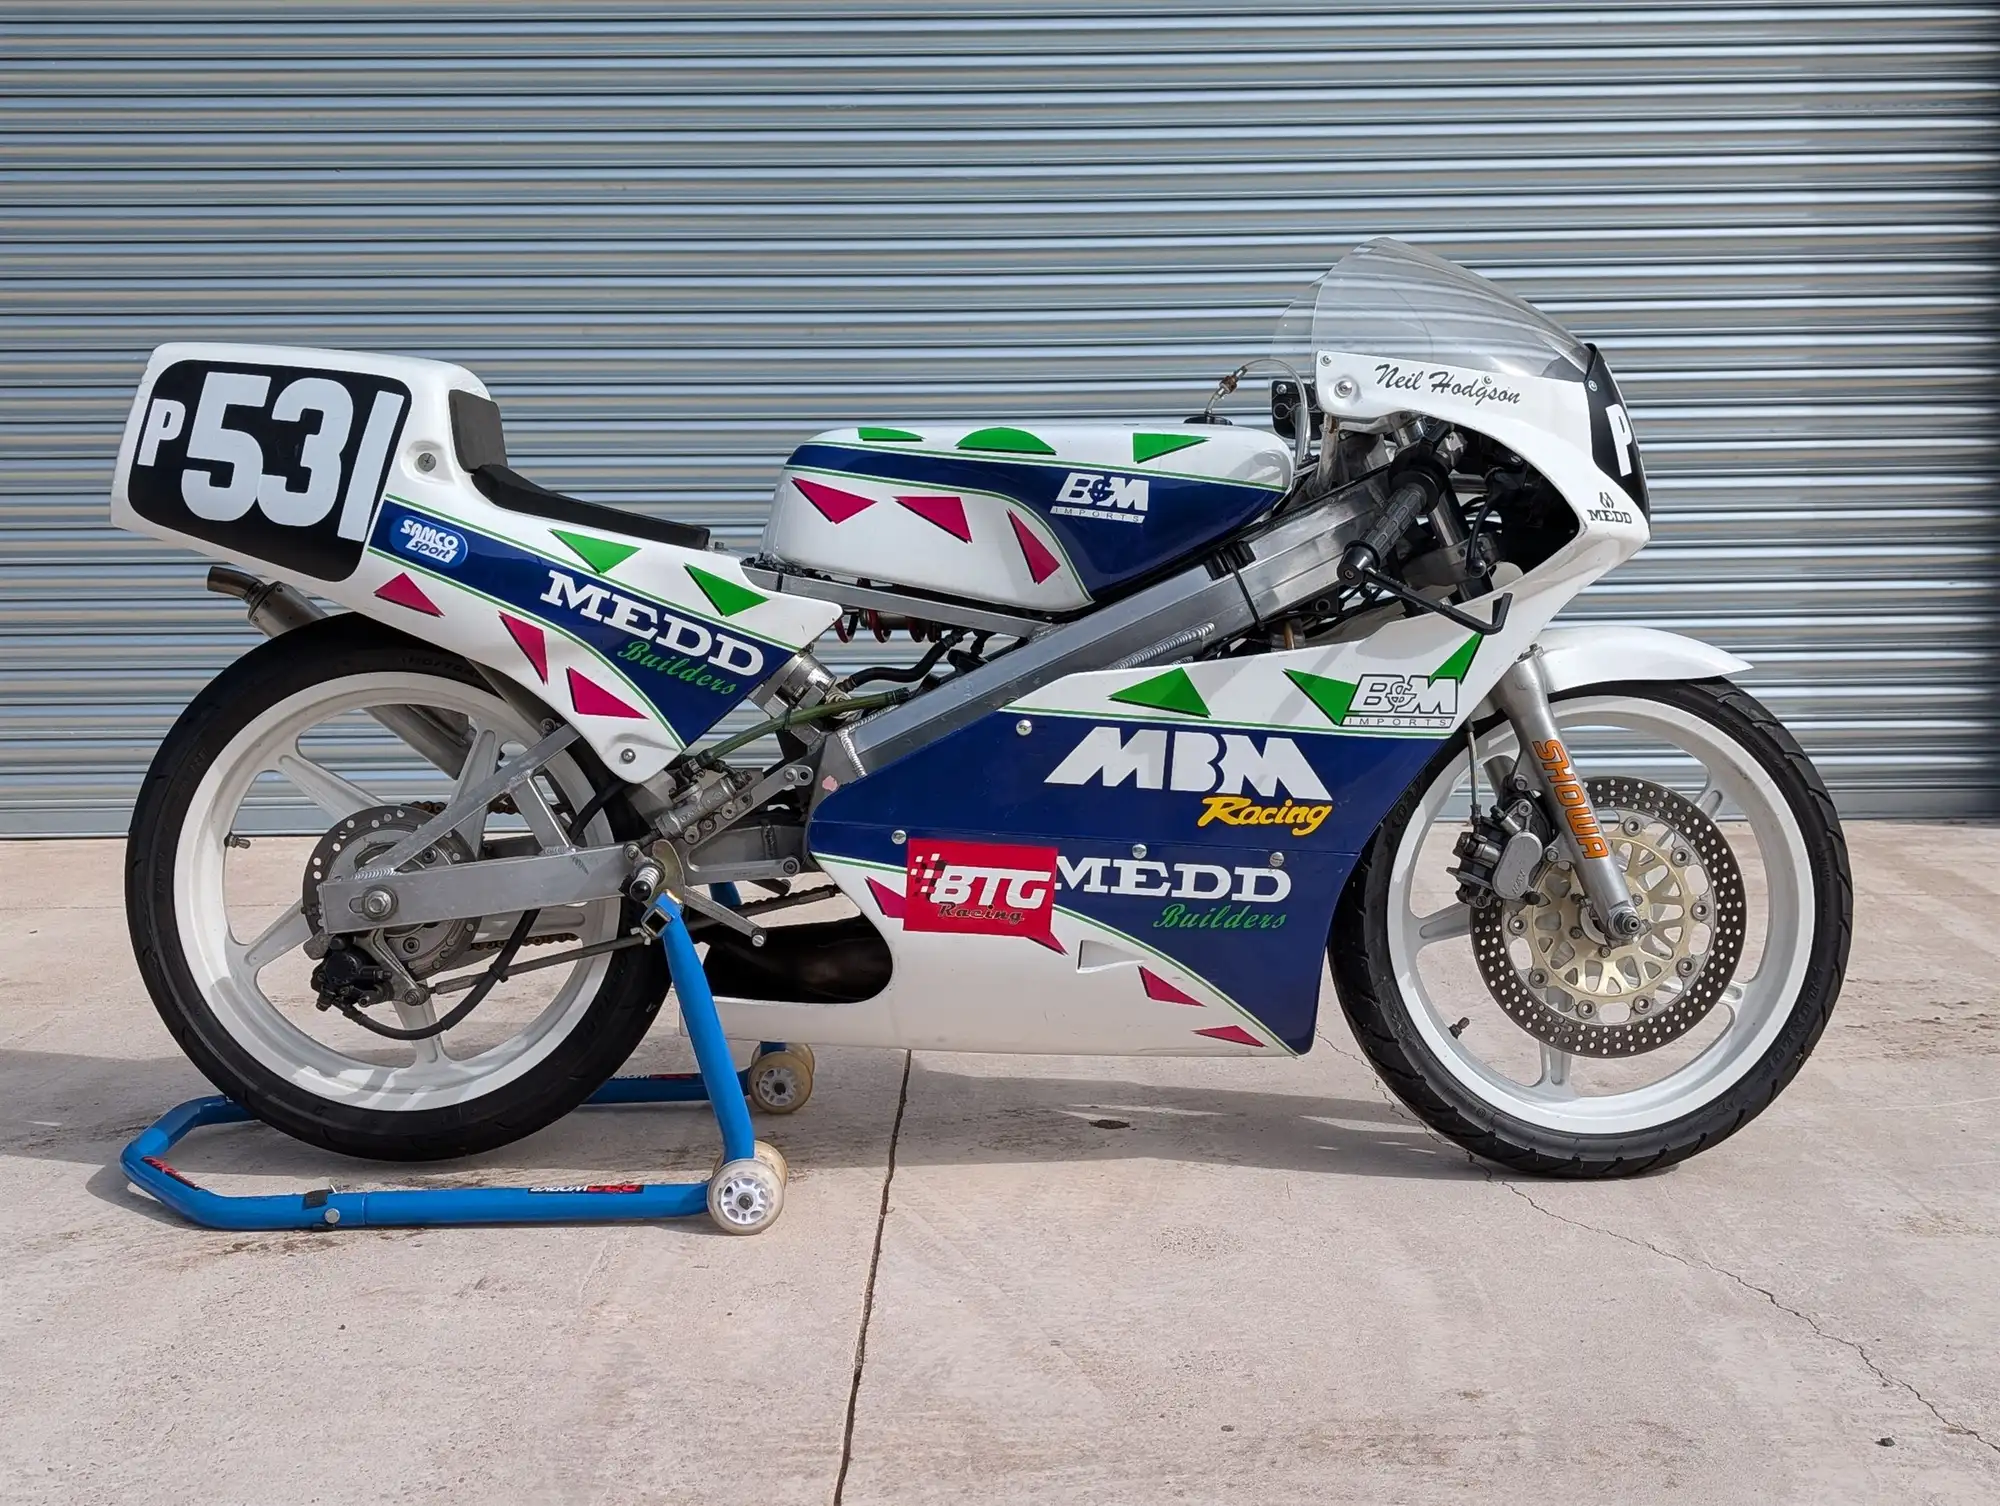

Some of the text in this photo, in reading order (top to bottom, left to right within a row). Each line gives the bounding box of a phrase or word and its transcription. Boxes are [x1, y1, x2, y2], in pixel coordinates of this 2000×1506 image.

[1374, 363, 1521, 406] Neil Hodgson
[137, 371, 405, 542] P 531
[1605, 403, 1633, 477] P
[1055, 472, 1150, 511] B&M
[400, 519, 459, 550] SAMCO
[1053, 507, 1141, 523] IMPORTS
[1587, 509, 1633, 524] MEDD
[539, 569, 764, 677] MEDD
[617, 640, 739, 695] Builders
[1346, 673, 1458, 714] B&M
[1348, 717, 1447, 727] IMPORTS
[1044, 726, 1333, 801] MBM
[1197, 796, 1333, 836] Racing
[1532, 739, 1610, 860] SHOWA
[929, 864, 1052, 910] BTG
[1055, 855, 1292, 903] MEDD
[938, 901, 1025, 925] Racing
[1152, 903, 1288, 930] Builders
